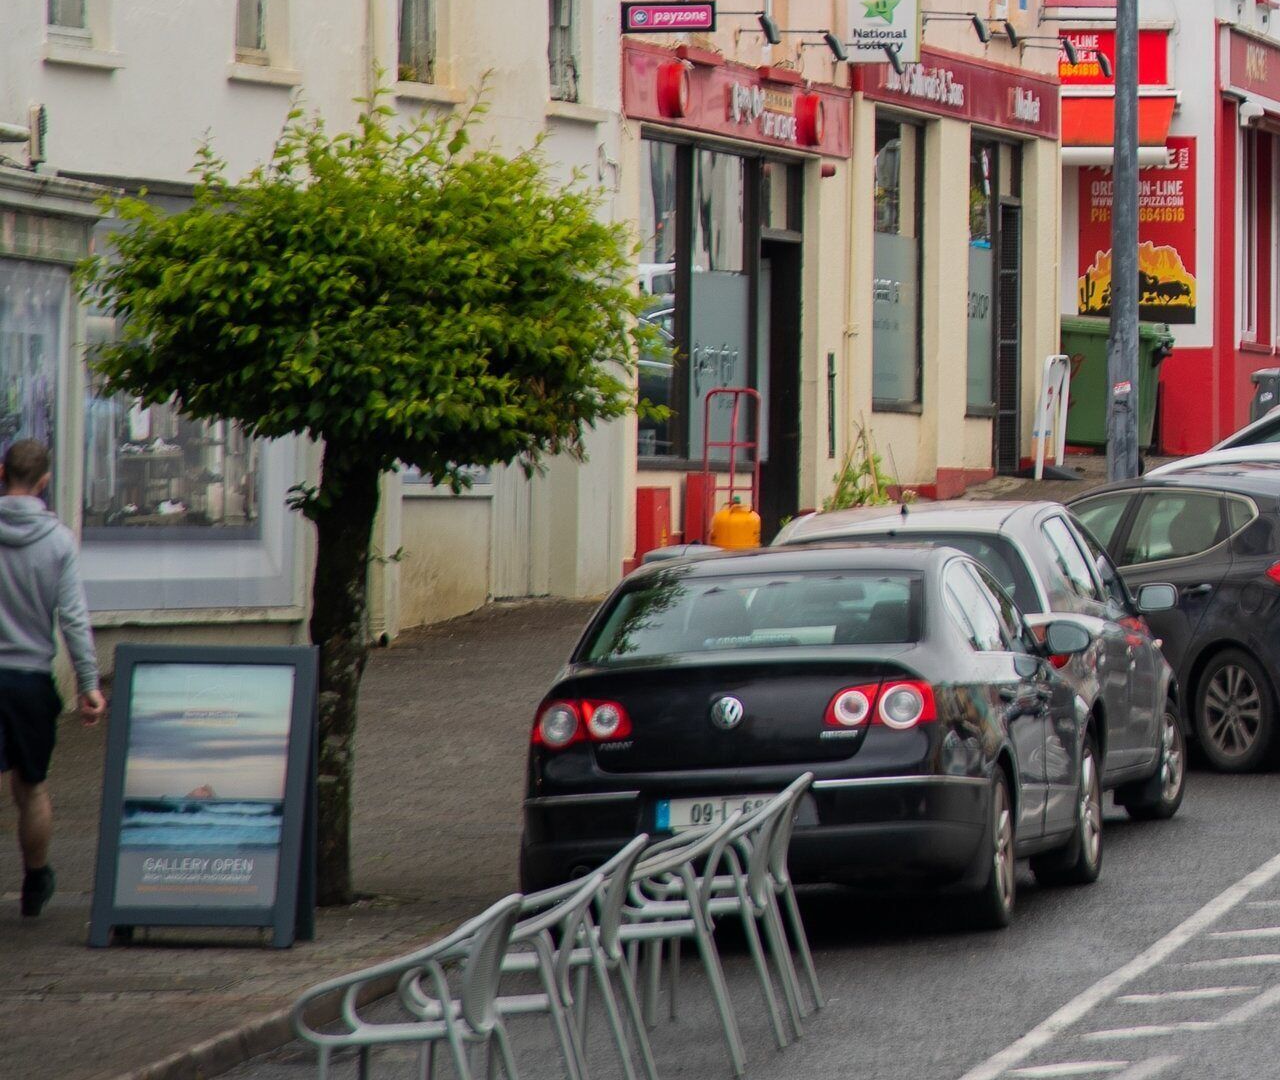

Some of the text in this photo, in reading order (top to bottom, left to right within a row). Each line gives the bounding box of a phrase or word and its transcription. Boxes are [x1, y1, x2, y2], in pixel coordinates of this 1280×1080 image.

[652, 9, 708, 25] payzone
[853, 28, 907, 39] National
[856, 40, 904, 53] Lottery
[1178, 147, 1190, 170] PIZZA
[1091, 182, 1113, 196] ORD
[1091, 208, 1111, 223] PH:
[144, 858, 253, 874] GALLERY OPEN
